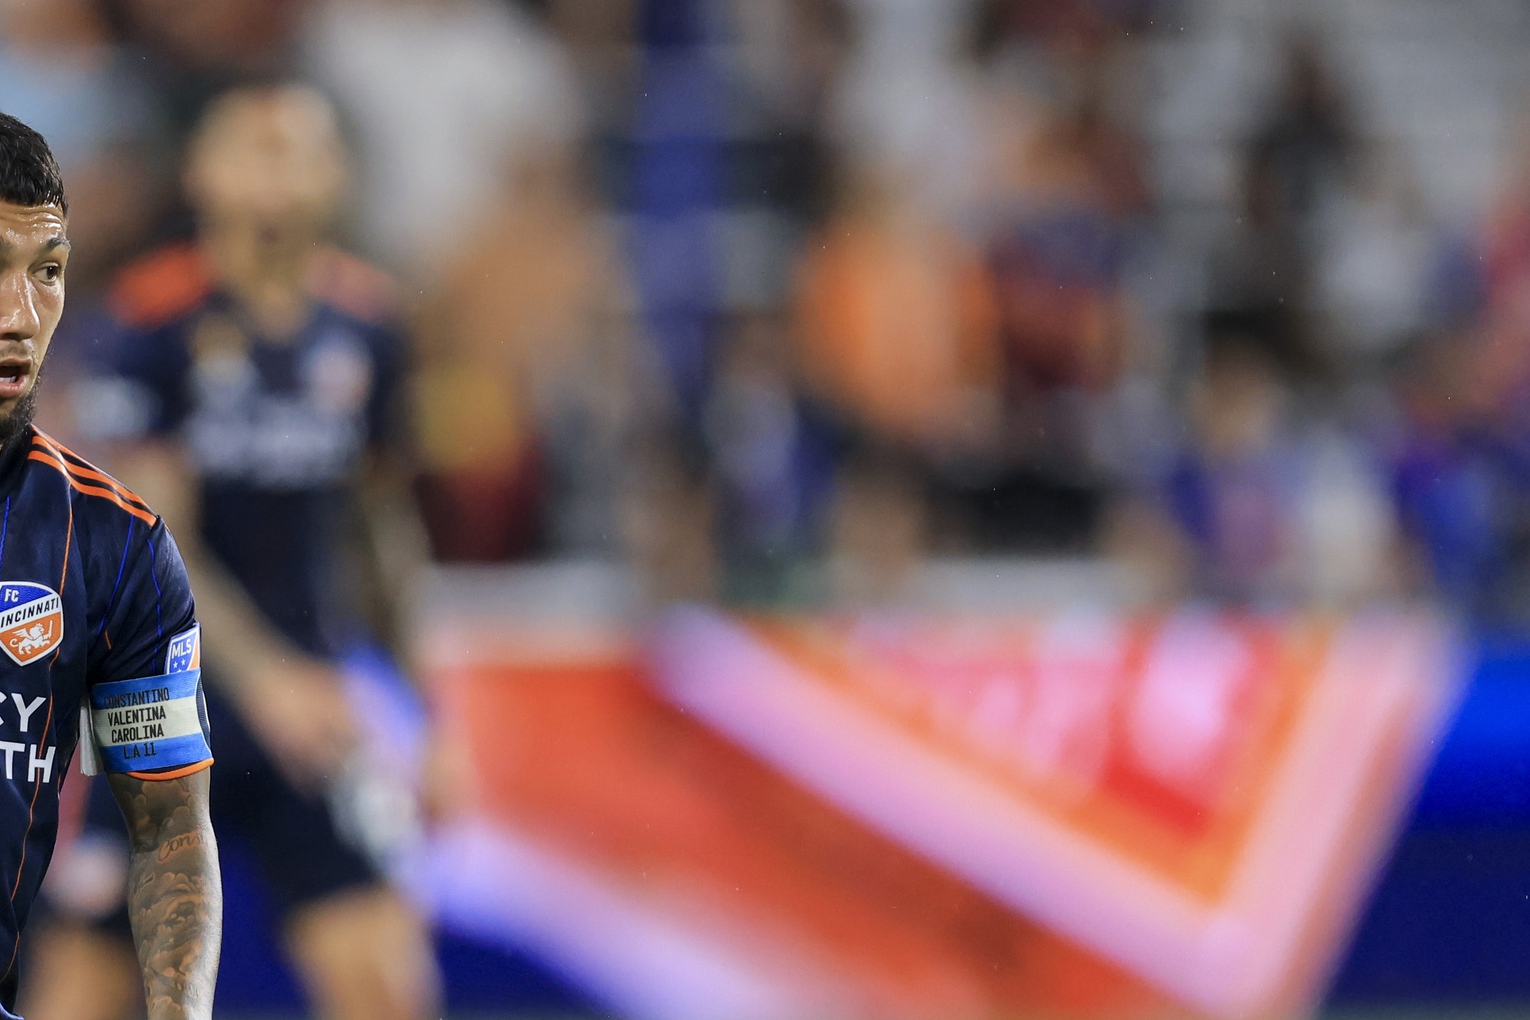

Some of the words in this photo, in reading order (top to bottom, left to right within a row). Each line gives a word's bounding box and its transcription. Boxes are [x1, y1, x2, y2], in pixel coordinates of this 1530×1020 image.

[3, 588, 19, 603] FC
[171, 638, 192, 659] MLS
[104, 687, 170, 709] CONSTANTINO
[107, 705, 167, 727] VALENTINA
[111, 723, 165, 744] CAROLINA
[143, 742, 157, 757] 11
